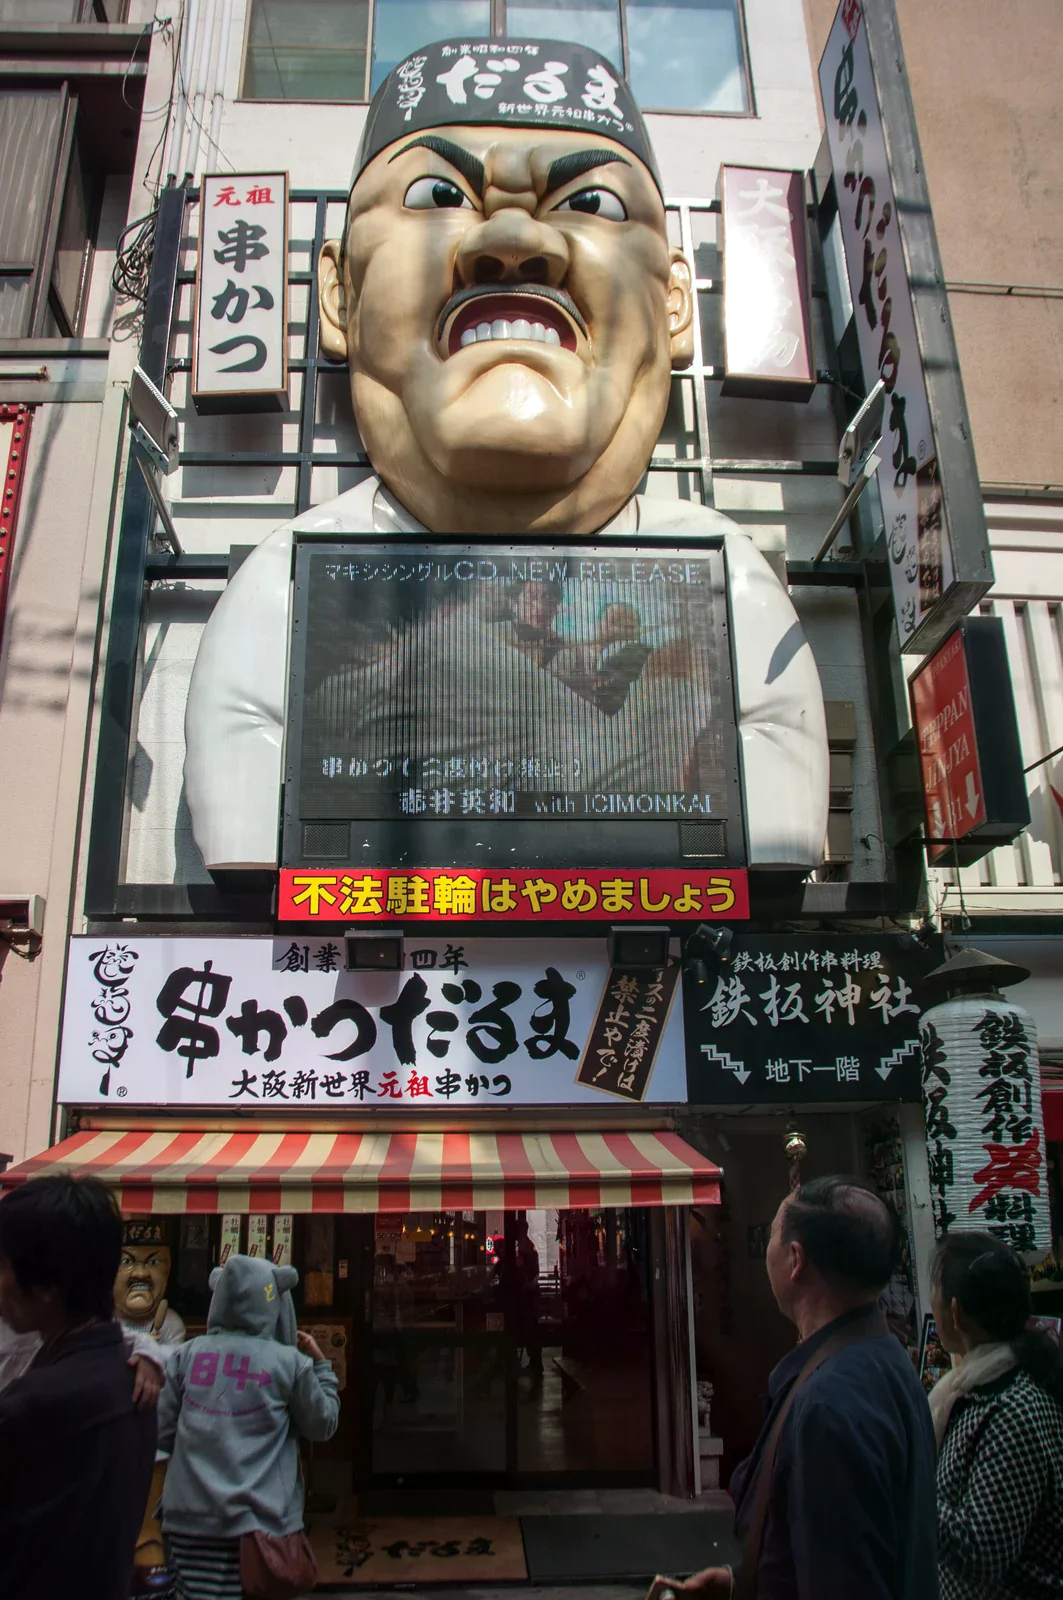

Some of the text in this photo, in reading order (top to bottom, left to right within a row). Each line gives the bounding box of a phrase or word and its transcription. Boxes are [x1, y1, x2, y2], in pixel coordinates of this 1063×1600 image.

[437, 55, 625, 119] だるま
[213, 185, 275, 207] 元祖
[208, 219, 275, 373] 串かつ
[511, 561, 568, 582] NEW
[580, 562, 701, 585] RELEASE
[922, 684, 969, 753] TEPPAN
[535, 795, 575, 813] with
[292, 875, 737, 915] 不法駐輪はやめましょう
[276, 942, 469, 975] 創業四年
[730, 948, 885, 973] 鉄板創作串料理
[699, 972, 921, 1028] 鉄板神社
[156, 960, 580, 1079] 串かつだるま
[228, 1068, 512, 1100] 大阪新世界元祖串かつ
[765, 1056, 860, 1082] 地下一階
